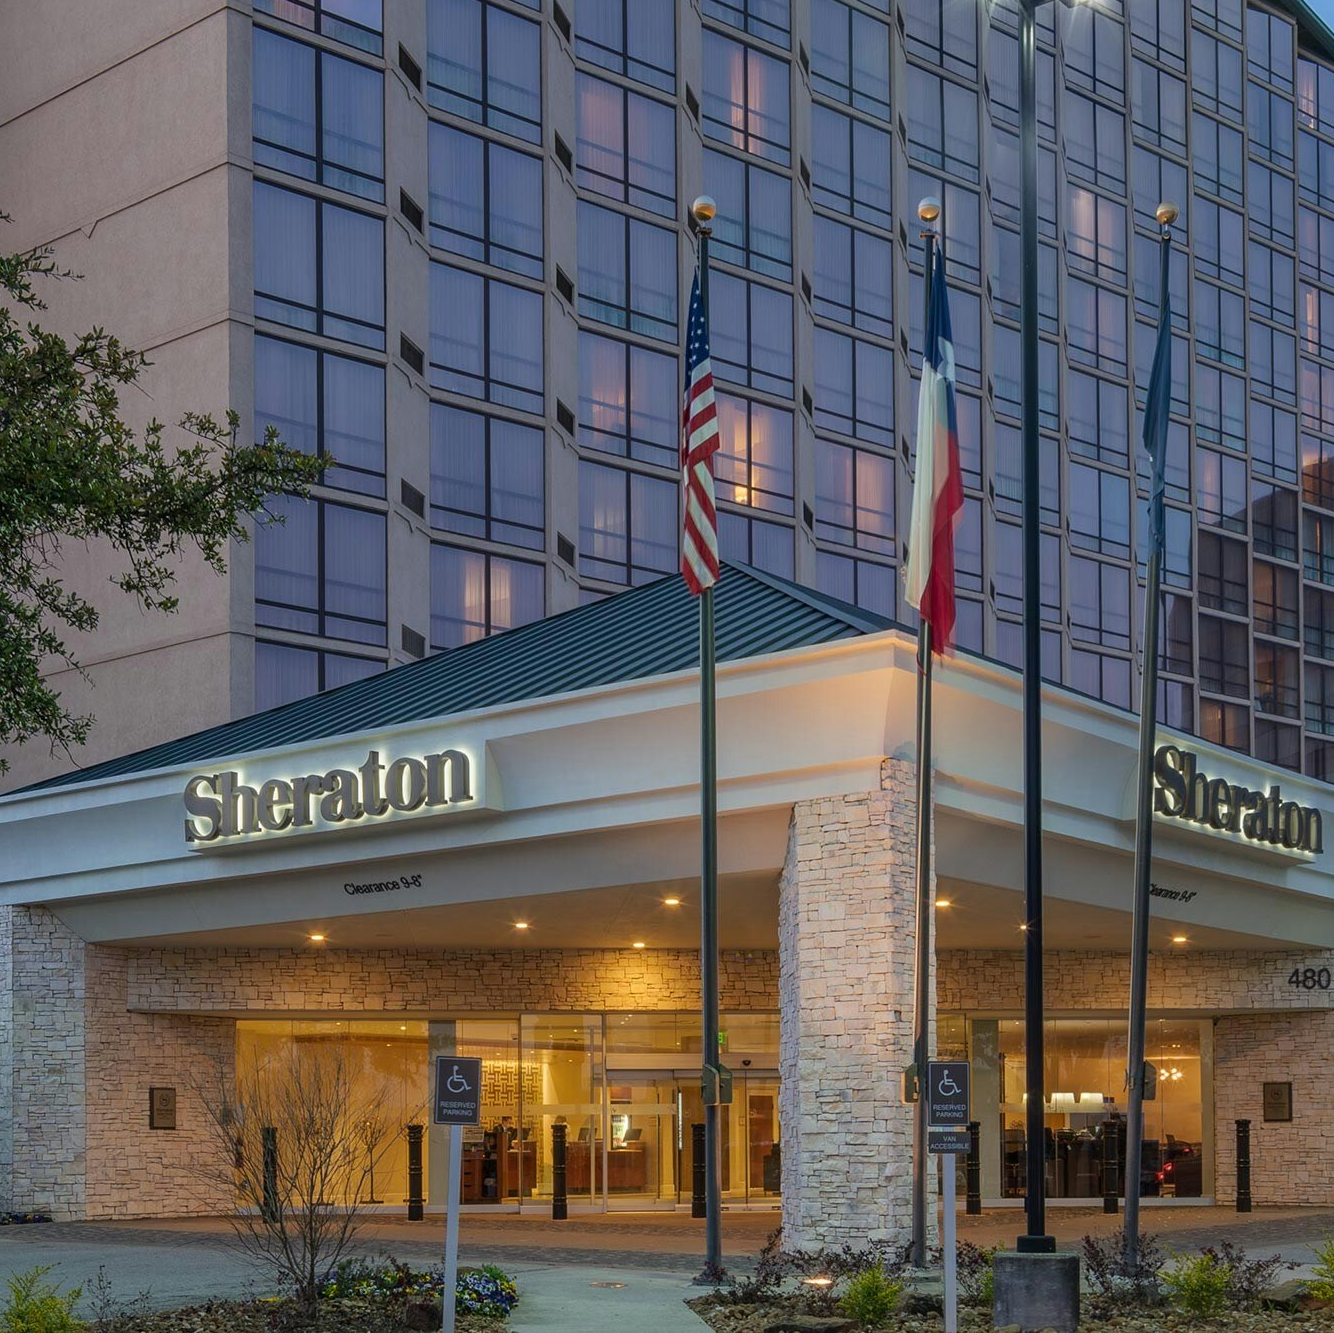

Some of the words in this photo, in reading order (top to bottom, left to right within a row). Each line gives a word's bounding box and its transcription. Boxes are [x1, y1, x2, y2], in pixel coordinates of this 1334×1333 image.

[184, 750, 474, 842] Sheraton
[1154, 745, 1324, 854] Sheraton
[344, 882, 400, 895] Clearance
[440, 1101, 476, 1109] RESERVED
